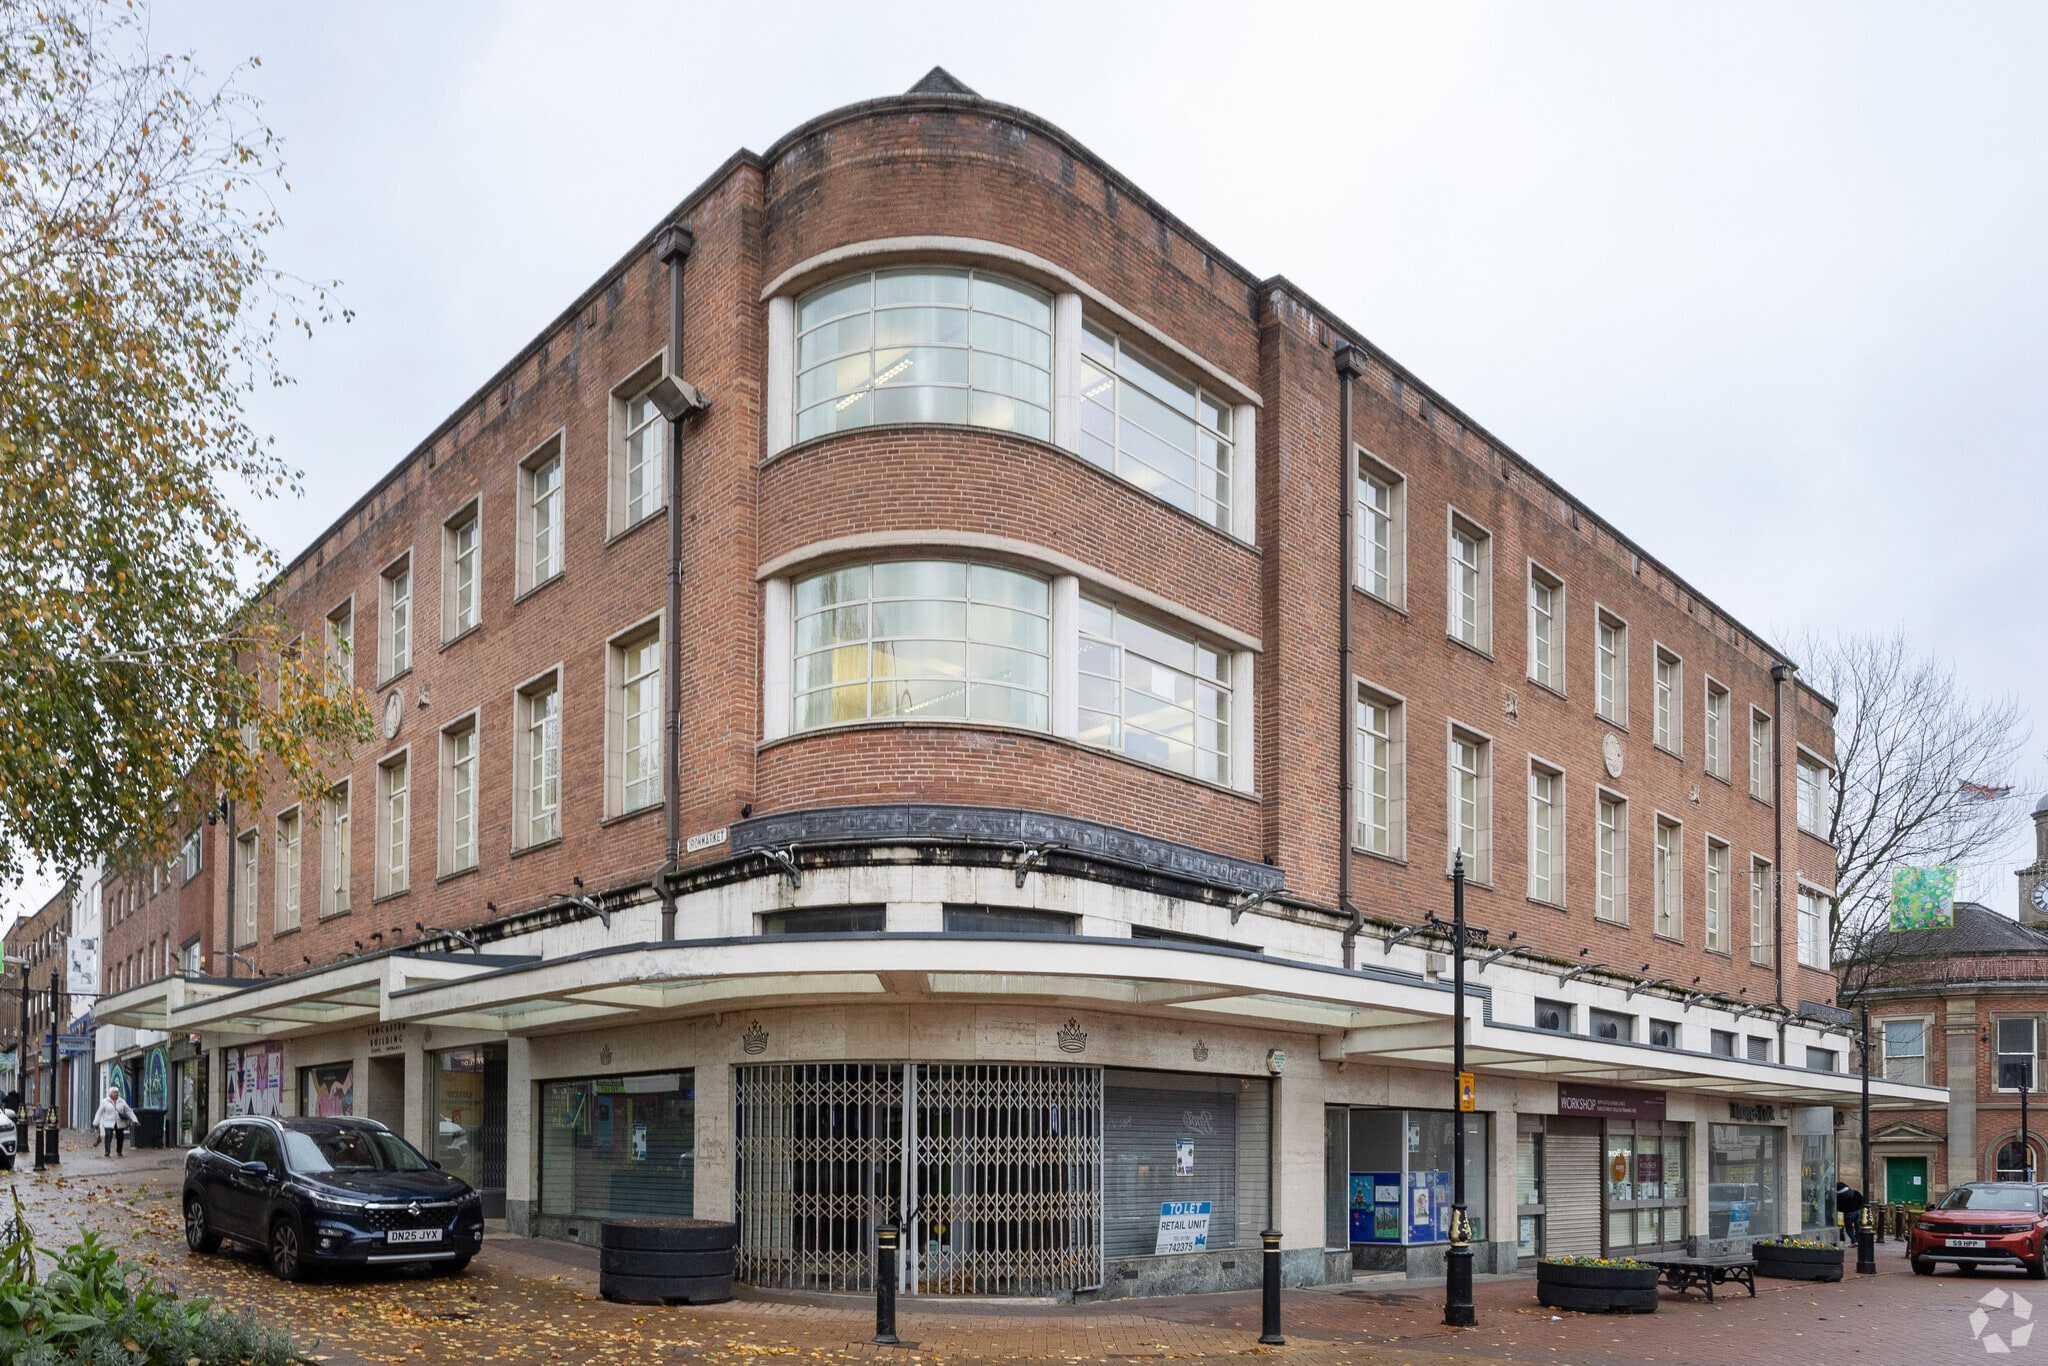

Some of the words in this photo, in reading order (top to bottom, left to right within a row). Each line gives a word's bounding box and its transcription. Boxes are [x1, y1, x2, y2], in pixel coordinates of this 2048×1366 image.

[689, 831, 725, 850] IRONMARKET
[368, 1022, 406, 1036] LANCASTER
[370, 1034, 403, 1047] BUILDING
[1560, 1097, 1596, 1111] WORKSHOP
[1170, 1203, 1183, 1215] TO
[1183, 1202, 1203, 1215] LET
[1161, 1220, 1186, 1231] RETAIL
[1187, 1219, 1207, 1230] UNIT
[391, 1231, 417, 1241] DN25
[419, 1230, 438, 1240] JYX
[1168, 1241, 1193, 1253] 742375
